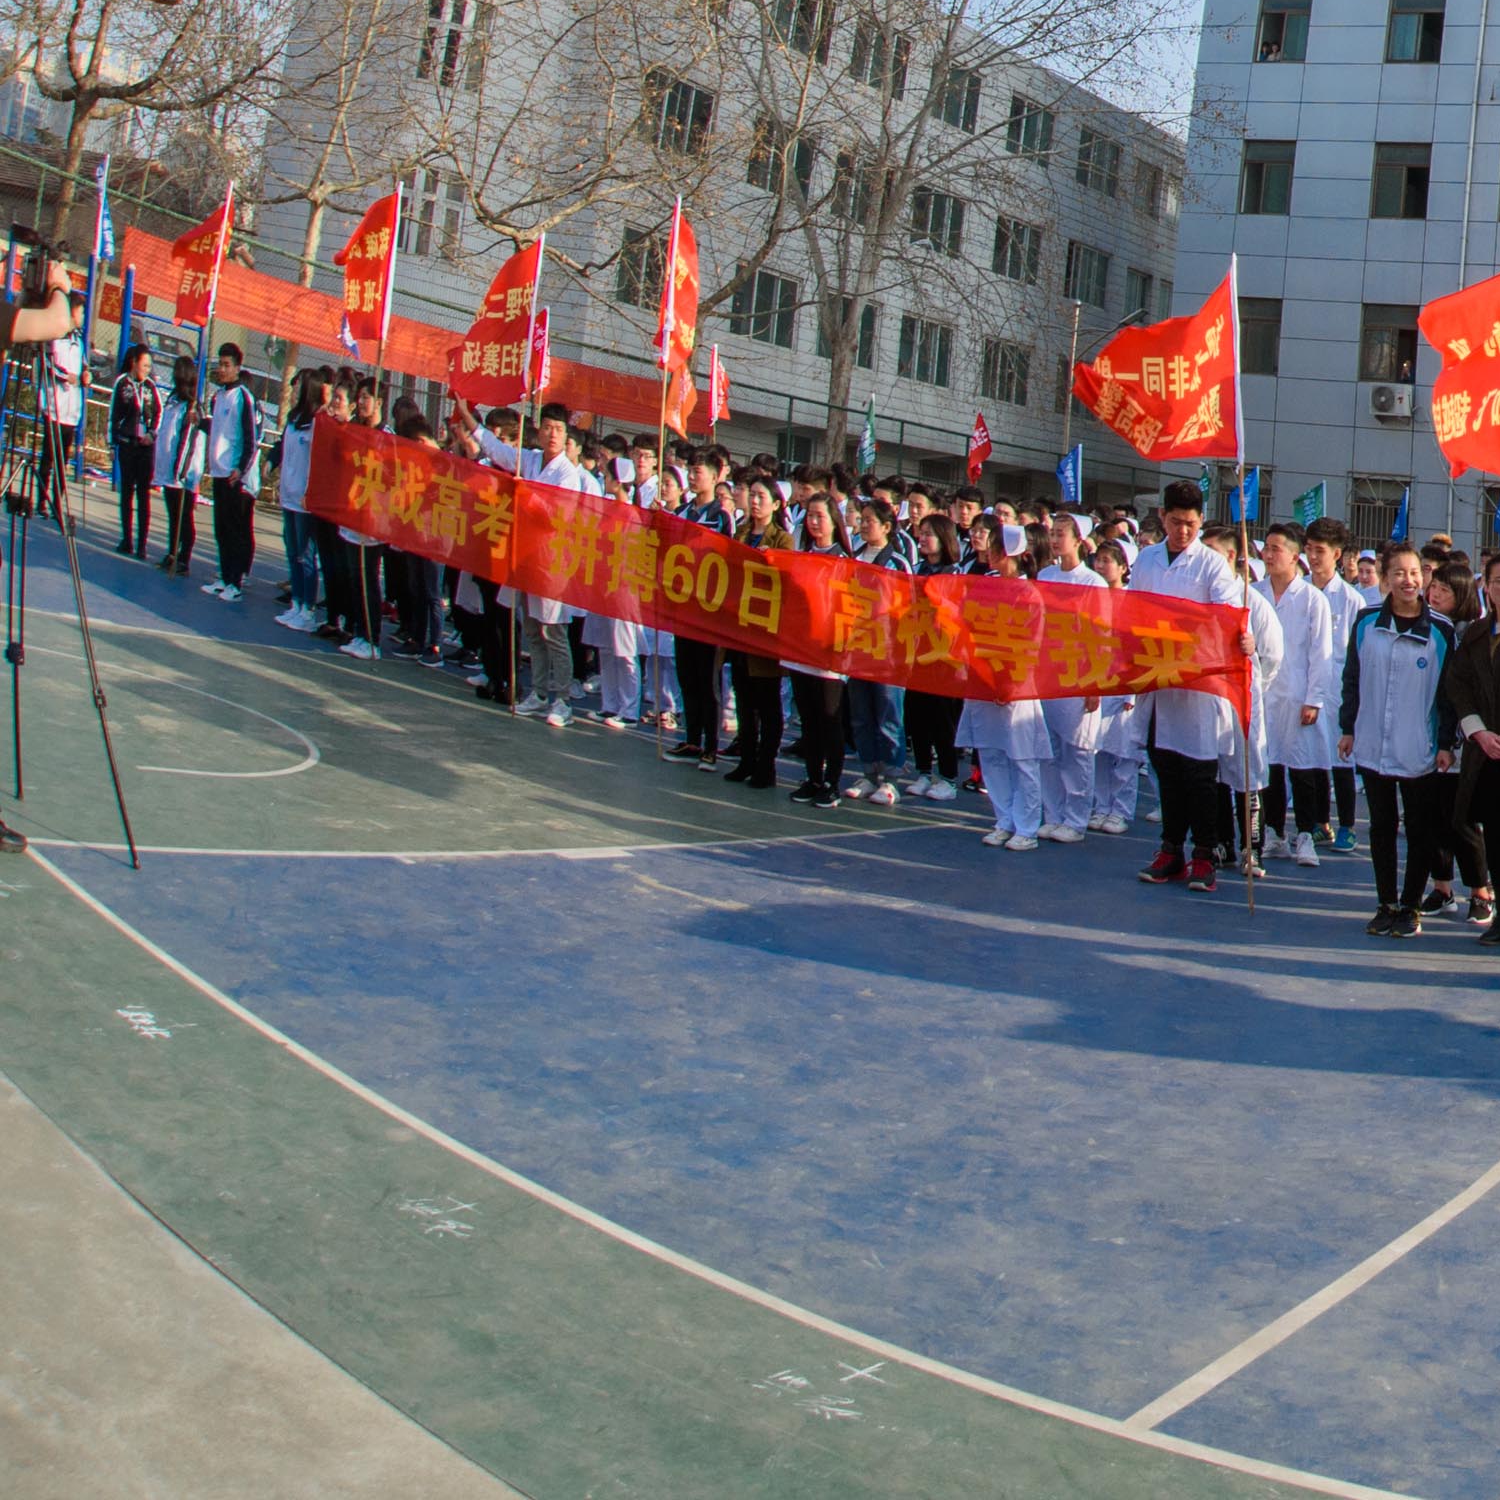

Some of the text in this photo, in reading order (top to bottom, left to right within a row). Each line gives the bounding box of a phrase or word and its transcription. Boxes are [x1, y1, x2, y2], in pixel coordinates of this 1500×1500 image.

[350, 450, 1202, 691] 决战高考 拼搏60日 高校等我来
